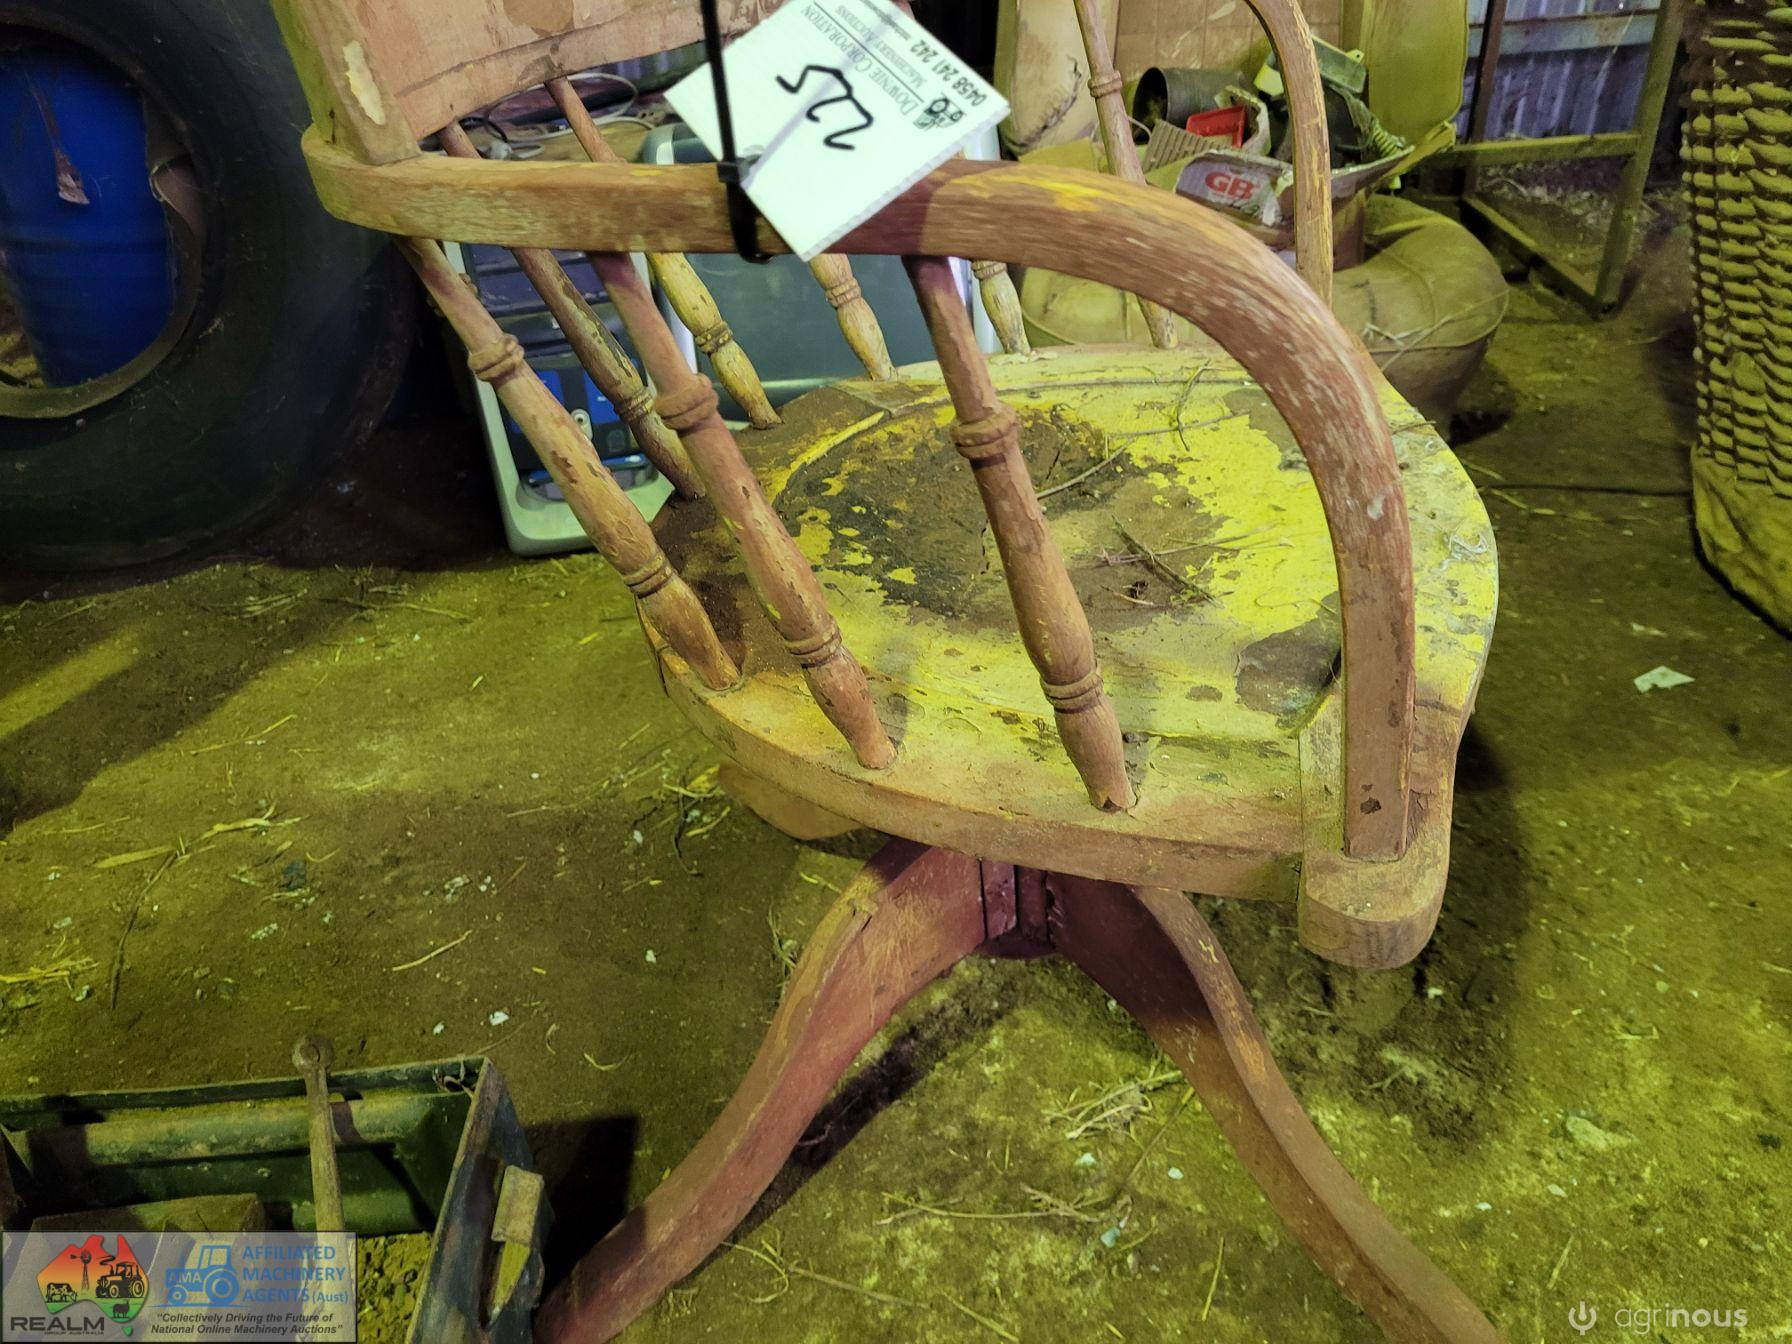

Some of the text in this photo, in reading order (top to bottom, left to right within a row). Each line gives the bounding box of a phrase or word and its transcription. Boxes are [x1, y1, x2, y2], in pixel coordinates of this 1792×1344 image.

[800, 5, 873, 73] CORPORATION
[836, 5, 879, 43] AUCTIONS
[868, 69, 919, 116] DOWNIE
[910, 39, 988, 107] 0458 241 242
[1205, 171, 1254, 200] GB
